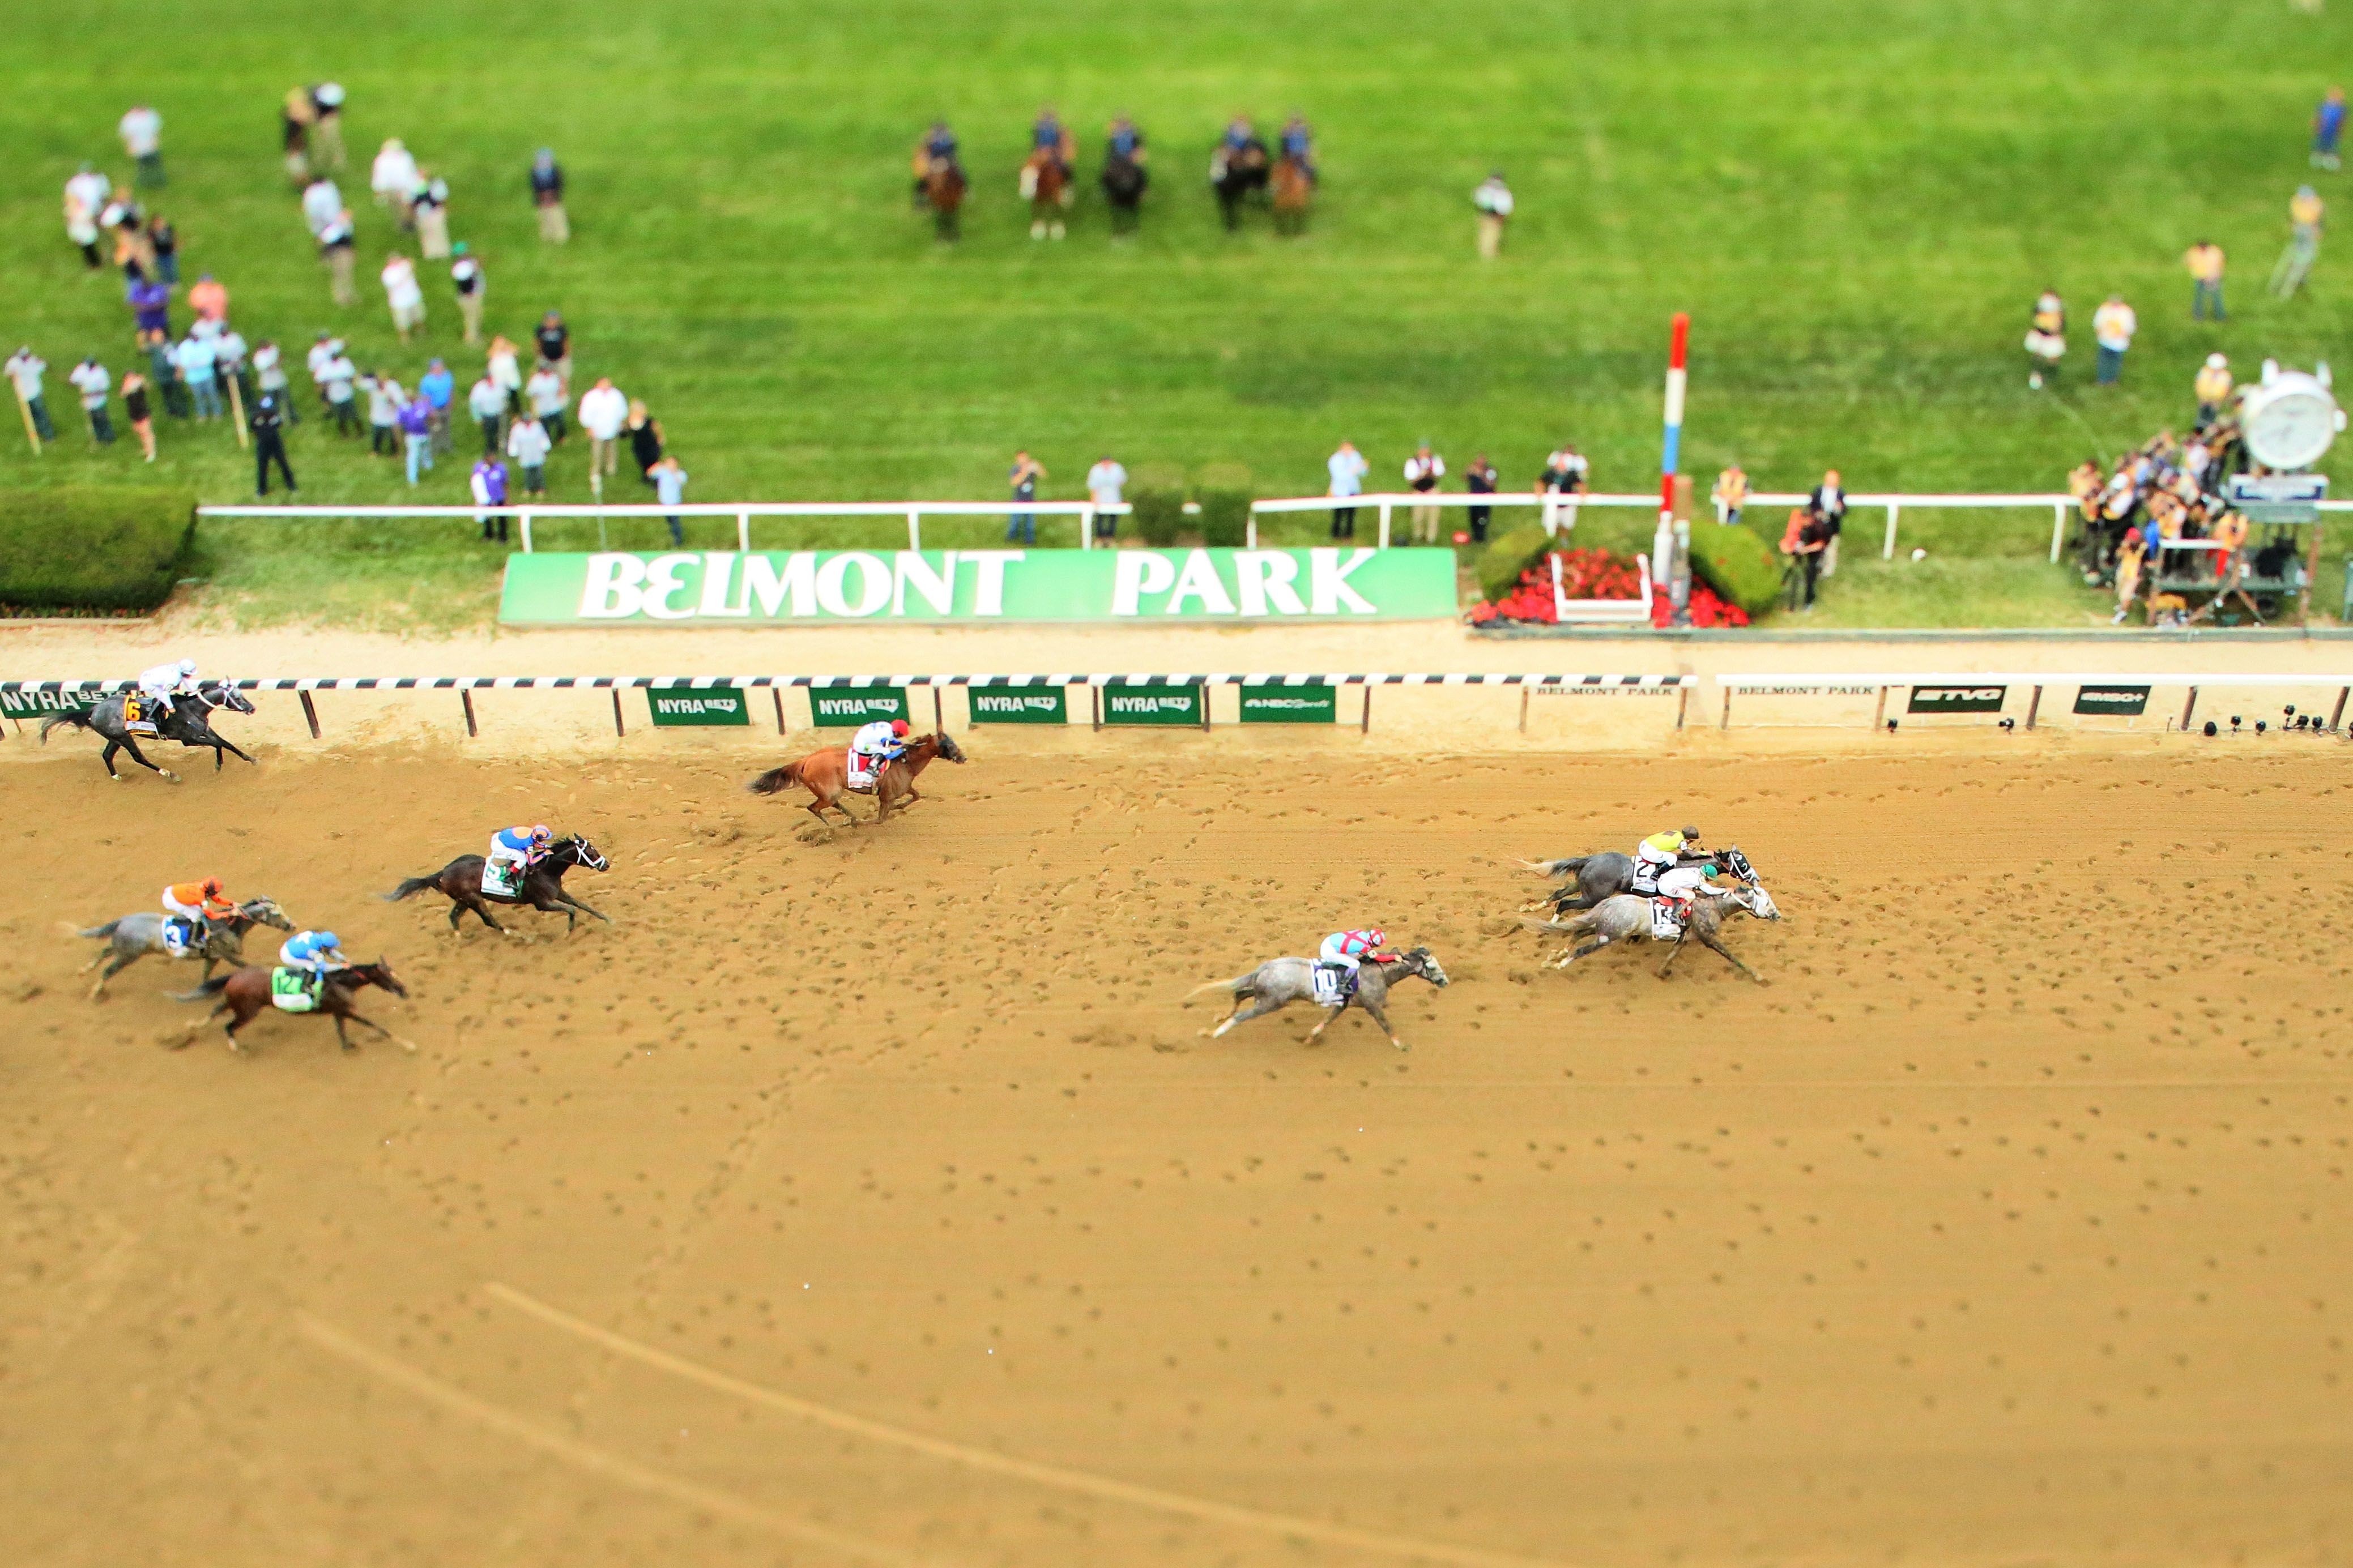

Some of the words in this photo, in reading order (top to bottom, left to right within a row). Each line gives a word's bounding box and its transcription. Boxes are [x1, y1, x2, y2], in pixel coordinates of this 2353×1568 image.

[579, 550, 1025, 619] BELMONT
[1111, 548, 1378, 616] PARK
[1537, 687, 1620, 695] BELMONT
[1737, 686, 1822, 695] BELMONT
[1827, 686, 1874, 695] PARK
[1942, 689, 2002, 700] TVG
[1, 691, 80, 711] NYRA
[658, 699, 706, 713] NYRA
[819, 699, 867, 714] NYRA
[977, 697, 1025, 712] NYRA
[1111, 697, 1160, 712] NYRA
[127, 702, 140, 721] 6
[851, 751, 859, 772] 1
[1636, 860, 1649, 878] 2
[1315, 968, 1338, 992] 10
